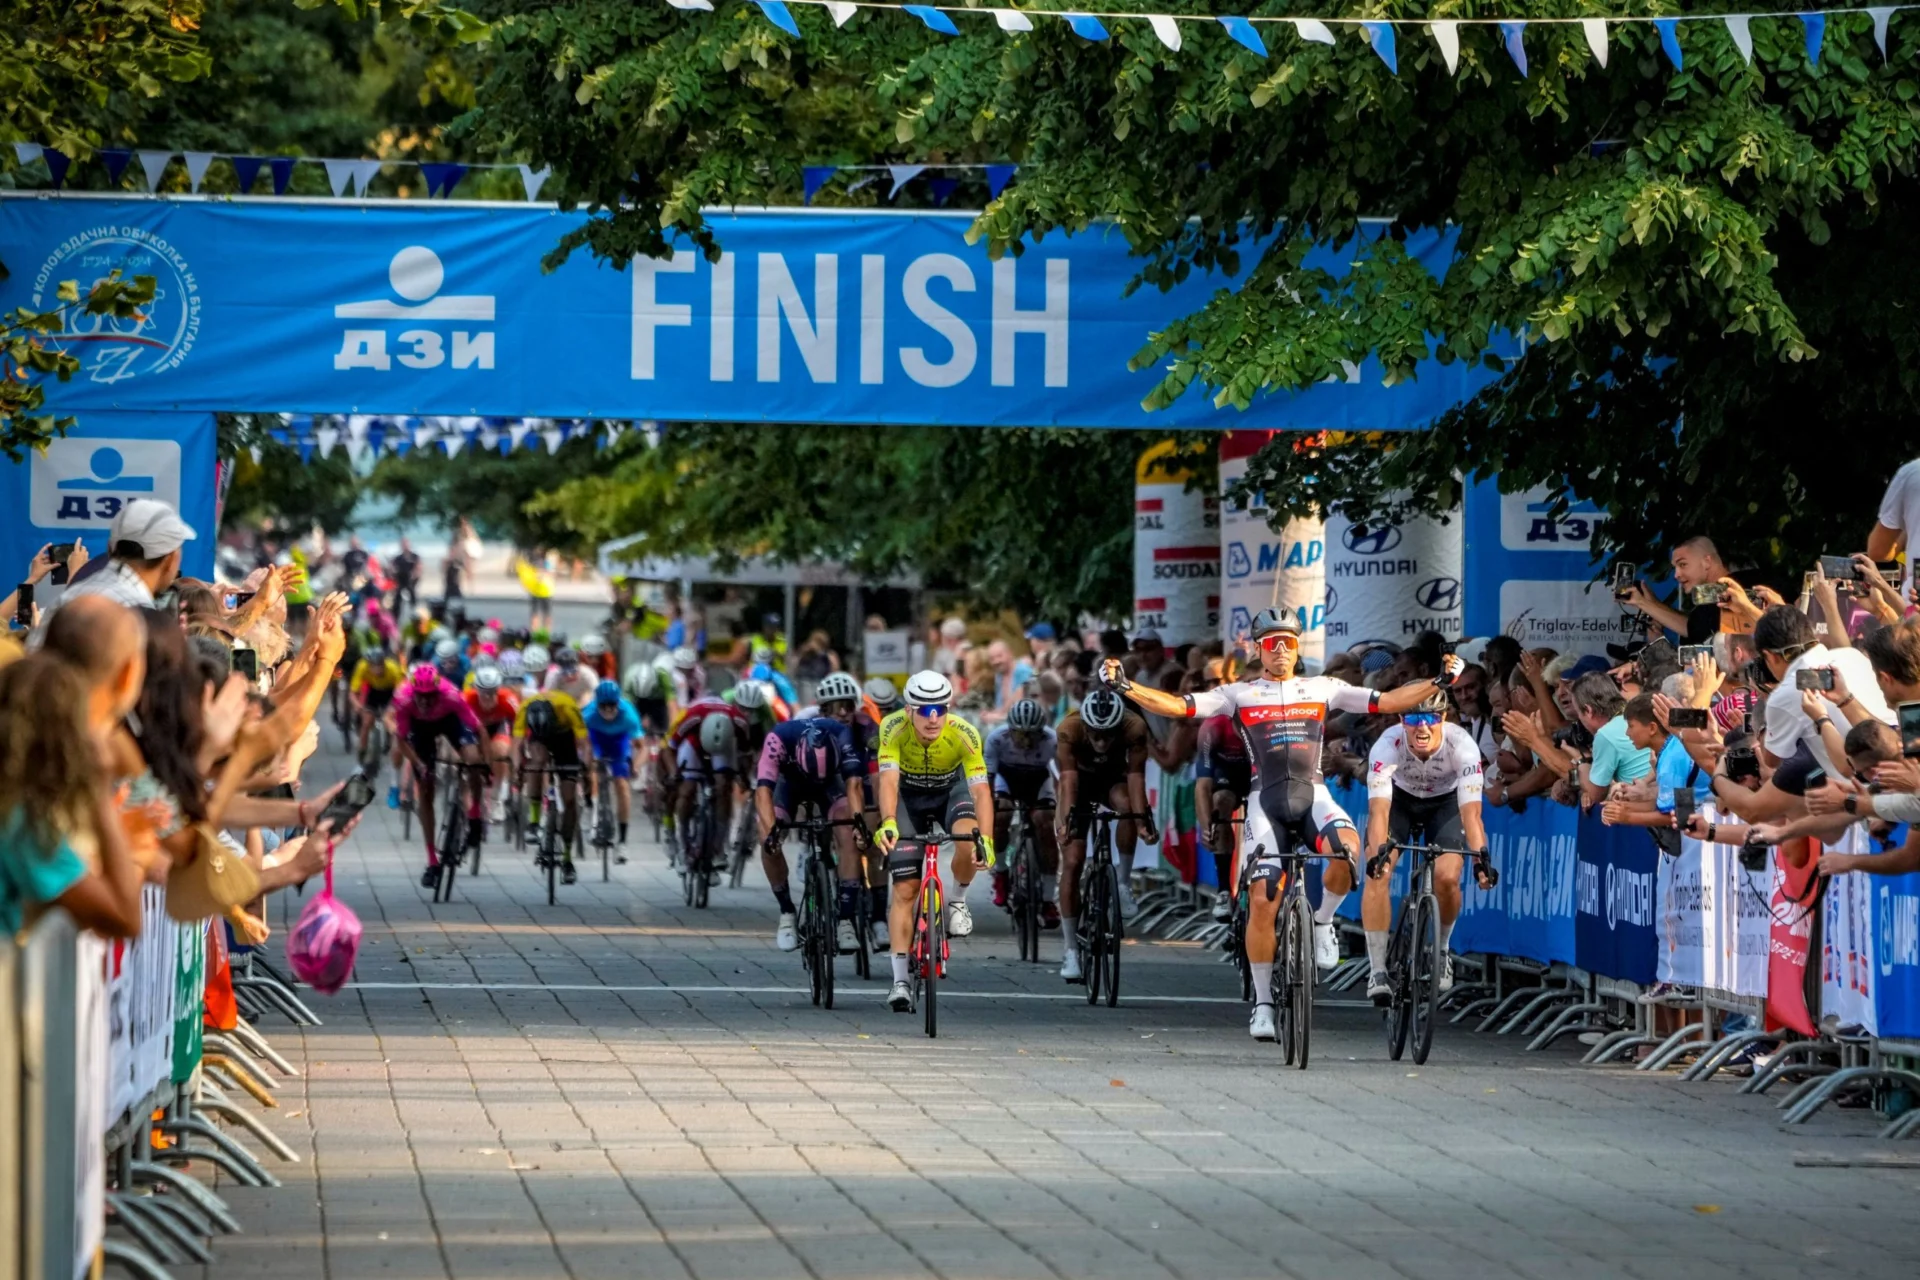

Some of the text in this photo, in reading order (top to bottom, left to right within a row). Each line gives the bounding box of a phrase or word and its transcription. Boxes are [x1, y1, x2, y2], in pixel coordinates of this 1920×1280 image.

[33, 225, 202, 369] КОЛОЕЗДАЧНА ОБИКОЛКА НА БЪЛГАРИЯ
[631, 251, 1070, 388] FINISH
[333, 329, 495, 371] ДЗИ
[57, 496, 152, 520] ДЗ
[1334, 560, 1418, 577] HYUNDAI
[1528, 618, 1621, 634] Triglav-Edelv
[957, 723, 980, 750] HUNGARY
